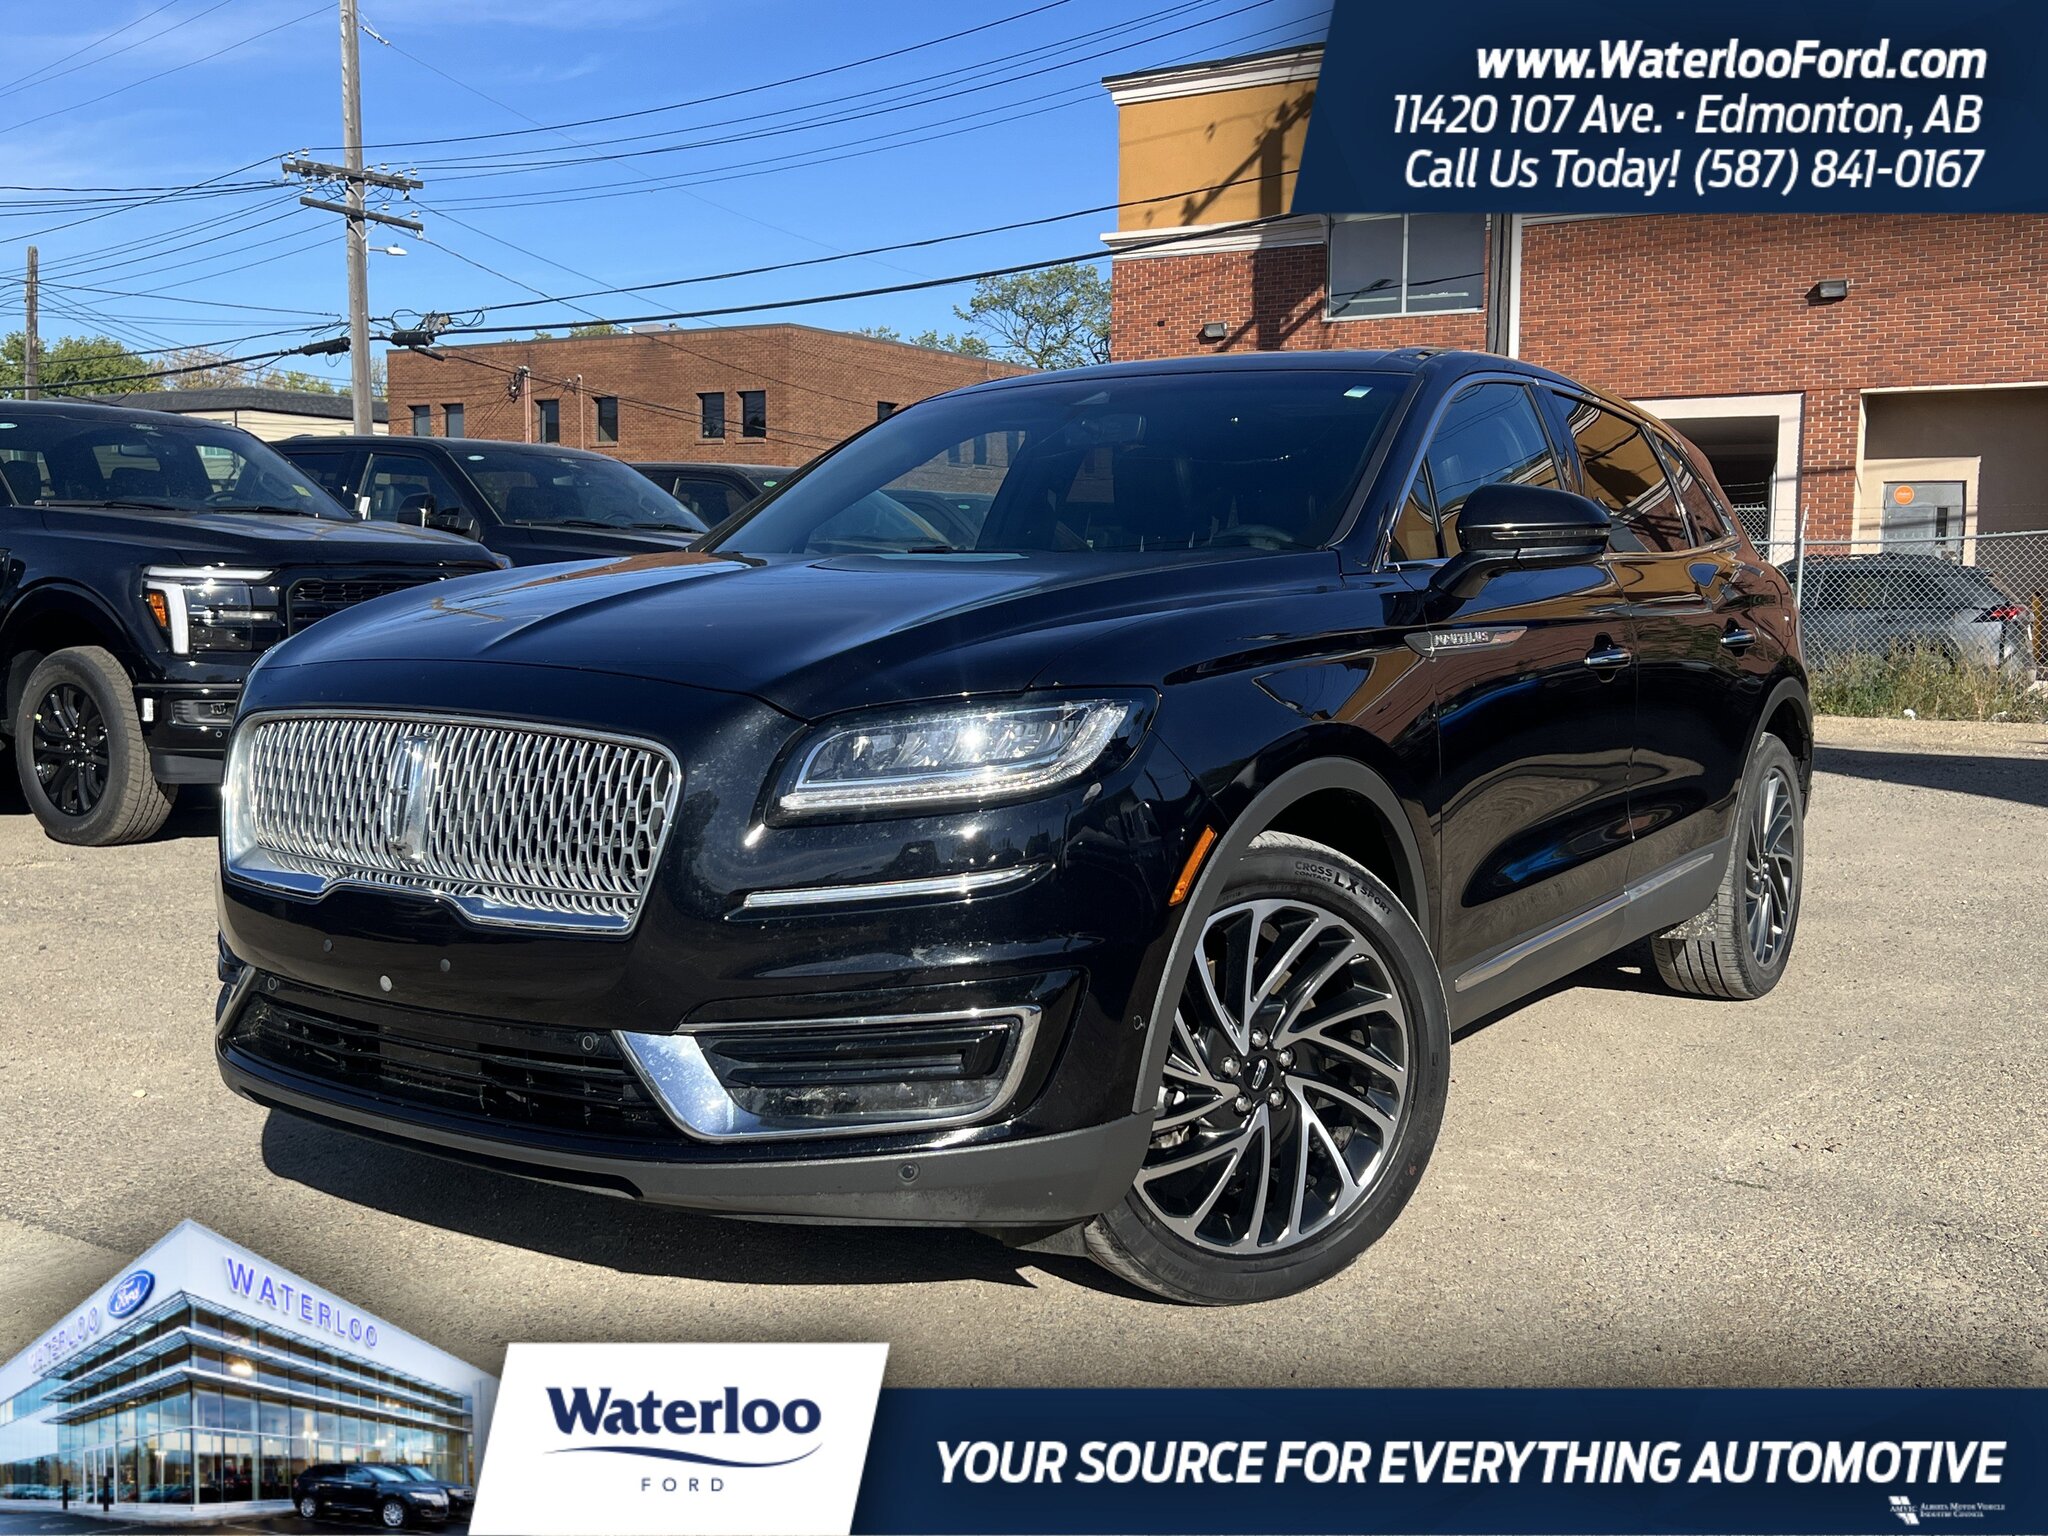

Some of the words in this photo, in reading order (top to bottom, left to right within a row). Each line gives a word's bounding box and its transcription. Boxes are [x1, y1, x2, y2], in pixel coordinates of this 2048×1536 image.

[1434, 631, 1489, 646] NAUTILUS
[1295, 861, 1333, 877] CROSS
[1295, 870, 1331, 882] CONTACT
[1334, 872, 1359, 895] LX
[1360, 886, 1393, 915] SPORT
